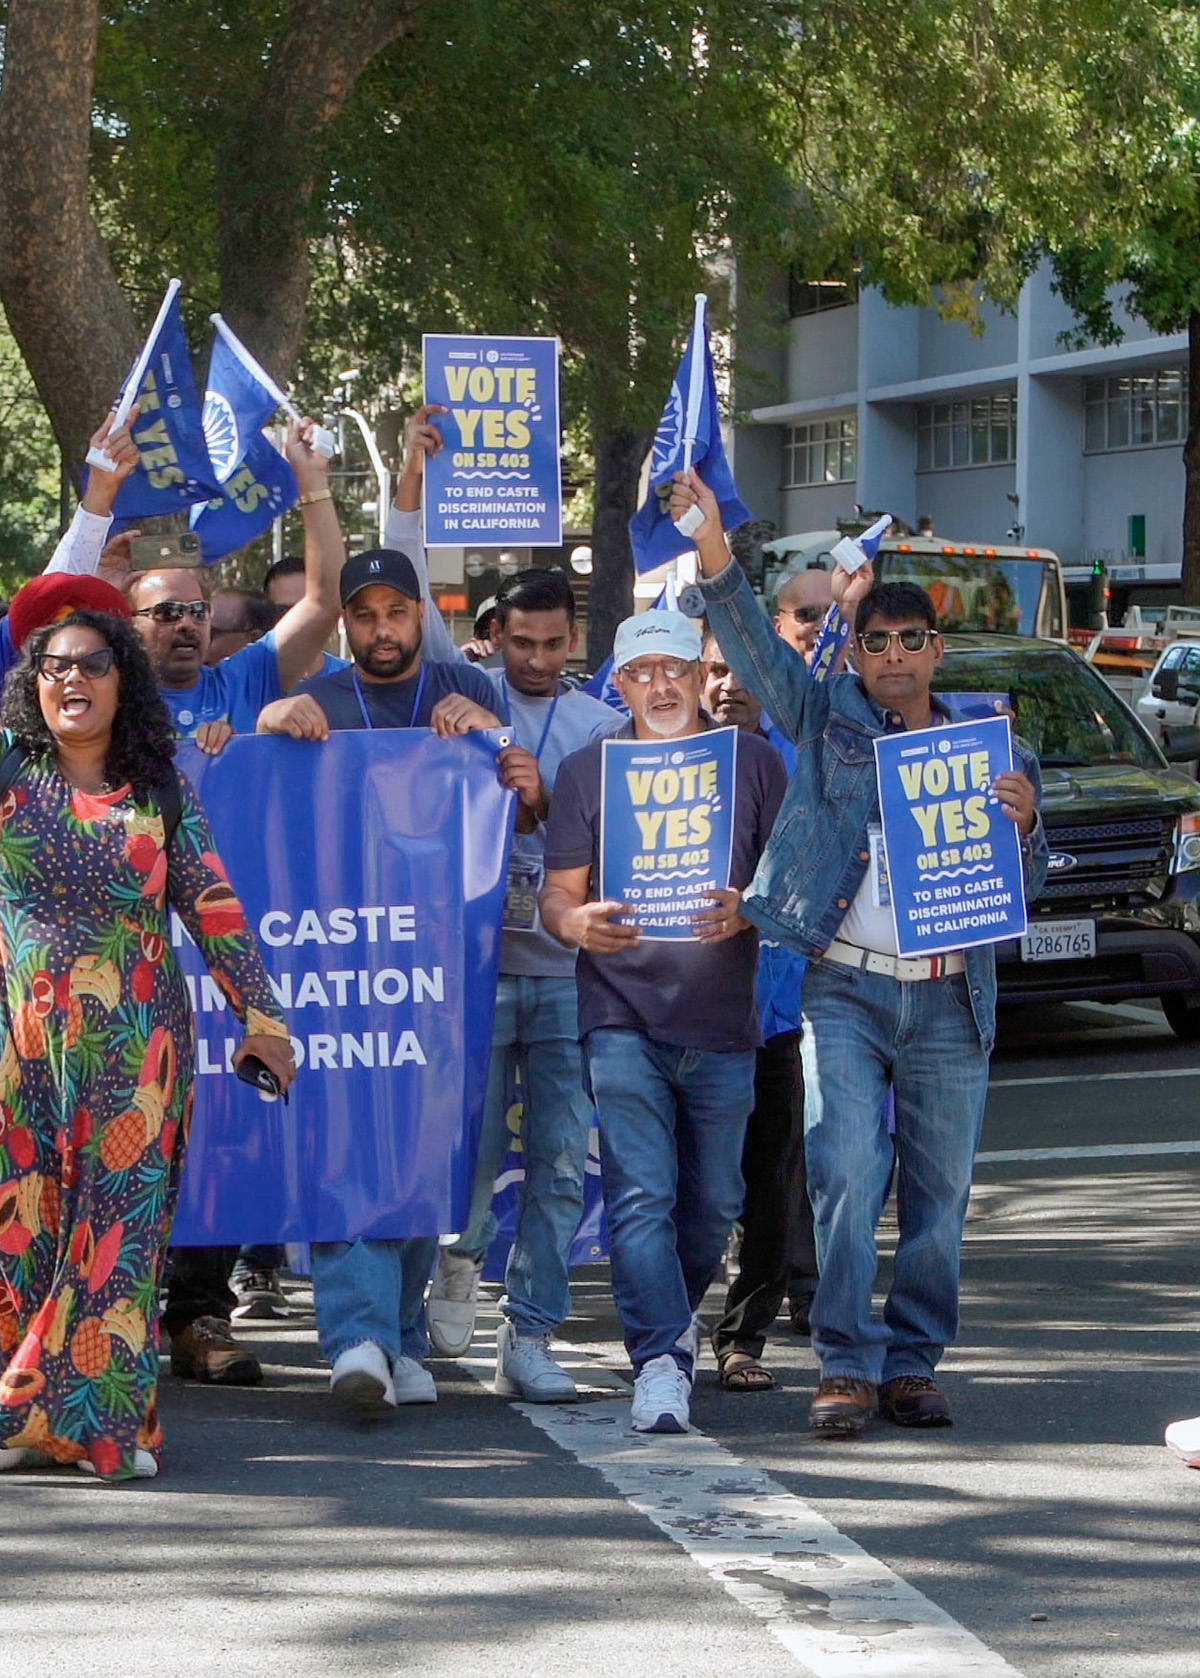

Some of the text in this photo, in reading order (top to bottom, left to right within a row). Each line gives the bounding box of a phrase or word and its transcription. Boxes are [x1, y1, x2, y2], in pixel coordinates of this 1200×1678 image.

[444, 366, 536, 403] VOTE
[452, 409, 531, 449] YES
[134, 418, 185, 489] YES
[452, 453, 530, 468] ON SB 403
[223, 462, 269, 514] ES
[445, 487, 539, 498] TO END CASTE
[438, 502, 546, 514] DISCRIMINATION
[445, 518, 540, 530] IN CALIFORNIA
[625, 760, 718, 806] VOTE
[898, 750, 991, 800] VOTE
[634, 804, 712, 850] YES
[910, 795, 990, 847] YES
[632, 848, 710, 870] ON SB 403
[917, 843, 992, 870] ON SB 403
[623, 880, 717, 899] TO END CASTE
[913, 877, 1004, 903] TO END CASTE
[908, 892, 1012, 921] DISCRIMINATION
[258, 905, 416, 947] CASTE
[917, 910, 1008, 936] IN CALIFORNIA
[1027, 934, 1091, 955] 1286765
